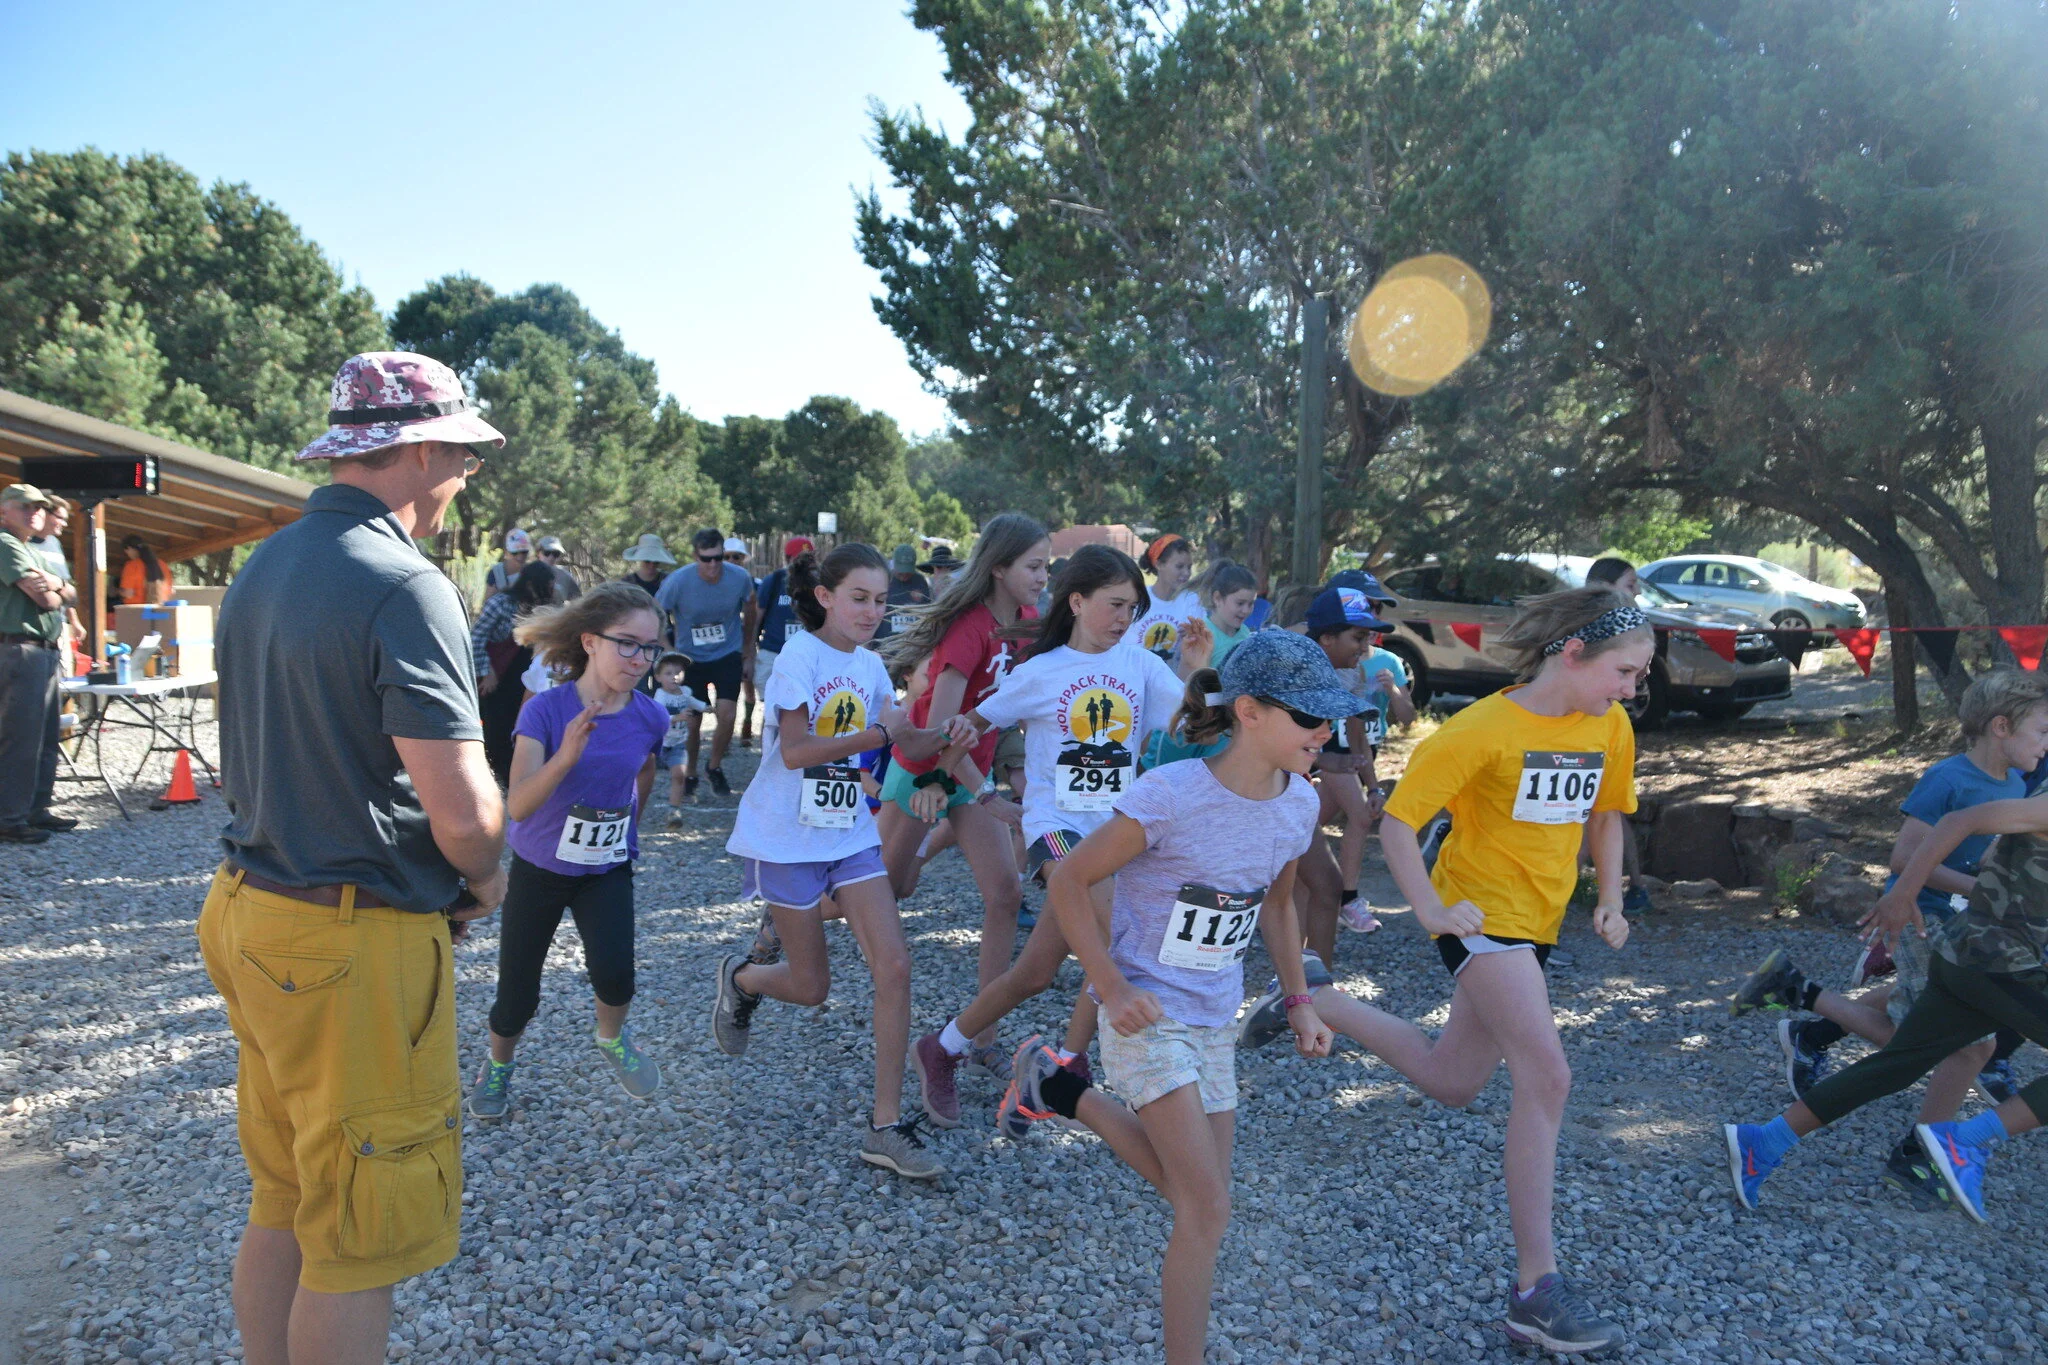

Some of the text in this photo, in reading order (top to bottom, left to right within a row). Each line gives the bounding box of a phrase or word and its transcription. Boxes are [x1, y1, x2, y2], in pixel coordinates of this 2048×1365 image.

[695, 626, 722, 637] 1115
[846, 676, 871, 709] TRAIL
[1057, 674, 1098, 737] WOLFPACK
[1101, 674, 1138, 704] TRAIL
[813, 780, 857, 809] 500
[1068, 767, 1122, 792] 294
[1526, 771, 1598, 802] 1106
[568, 820, 625, 847] 1121
[1176, 908, 1256, 946] 1122
